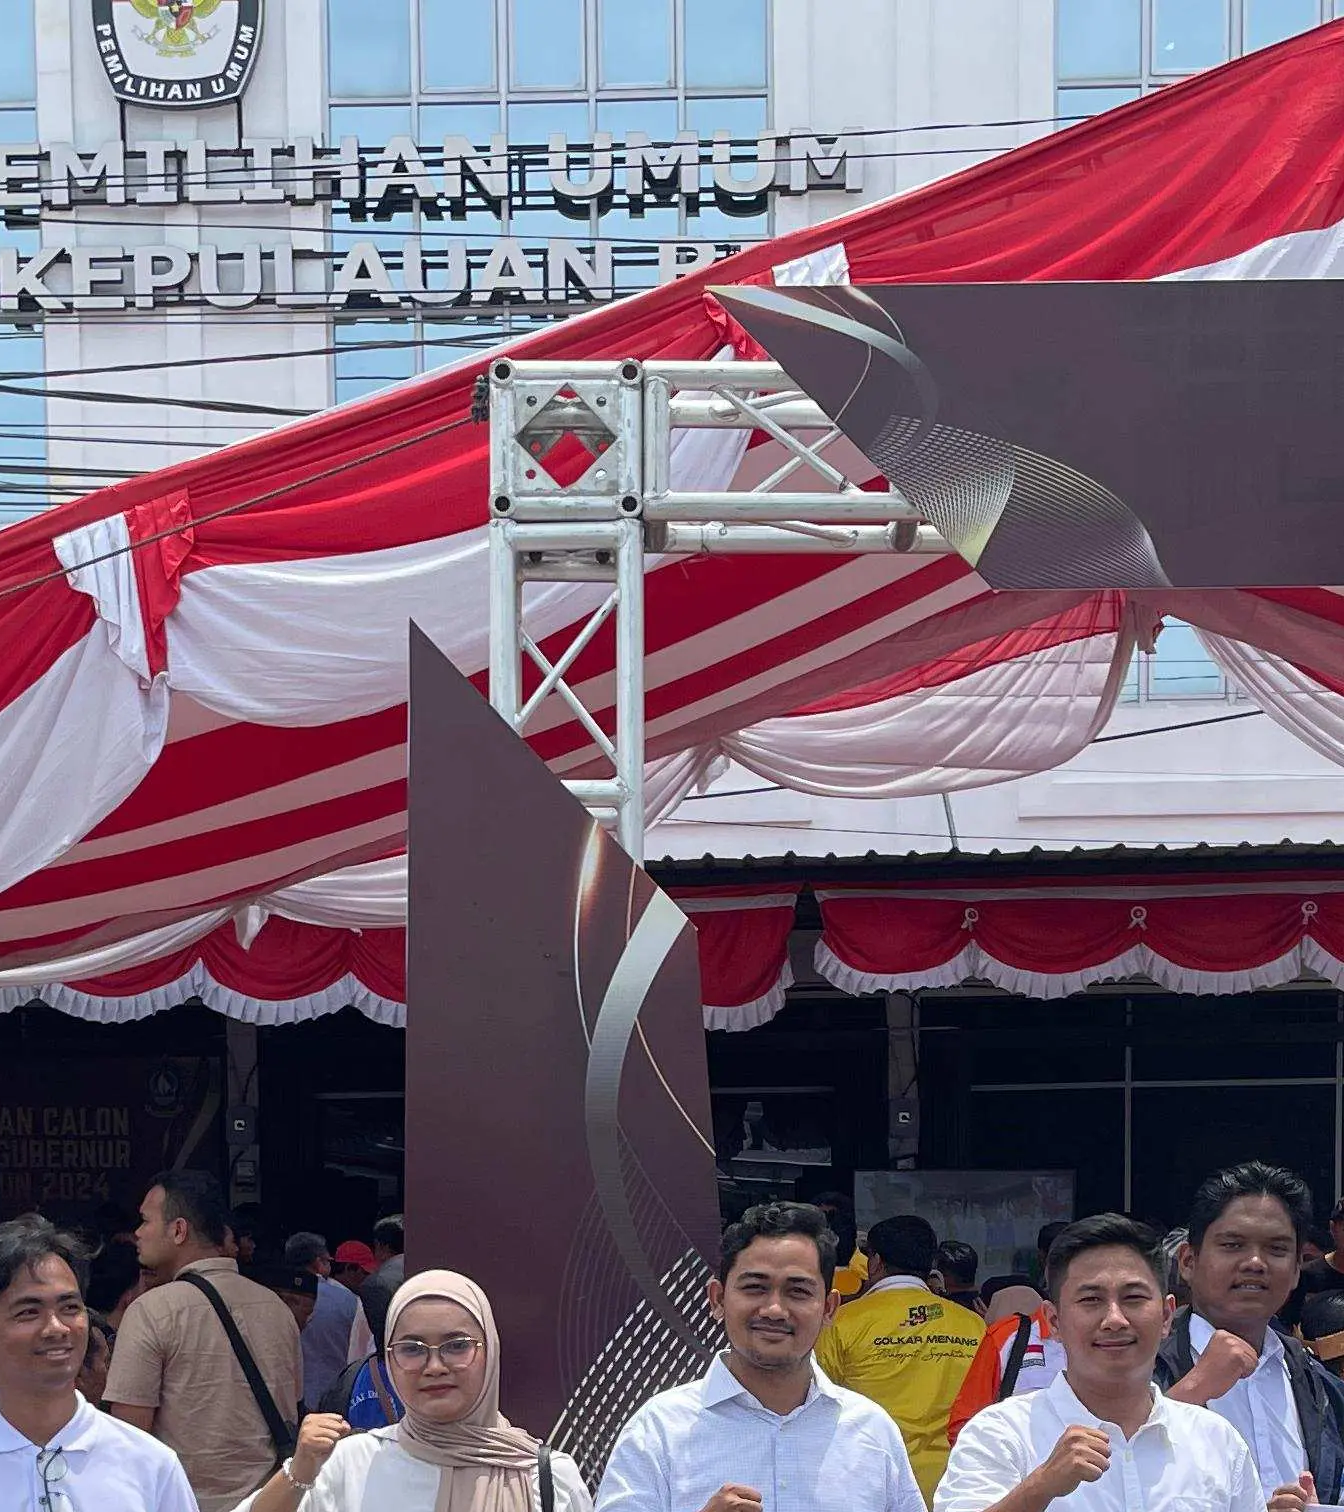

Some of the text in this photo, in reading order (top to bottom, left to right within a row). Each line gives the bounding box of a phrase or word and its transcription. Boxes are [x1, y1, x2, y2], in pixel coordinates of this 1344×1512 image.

[97, 24, 255, 100] PEMILIHAN UMUM
[547, 128, 863, 197] UMUM
[0, 237, 614, 313] KEPULAUAN
[43, 1106, 131, 1137] CALON
[873, 1334, 978, 1347] GOLKAR MENANG
